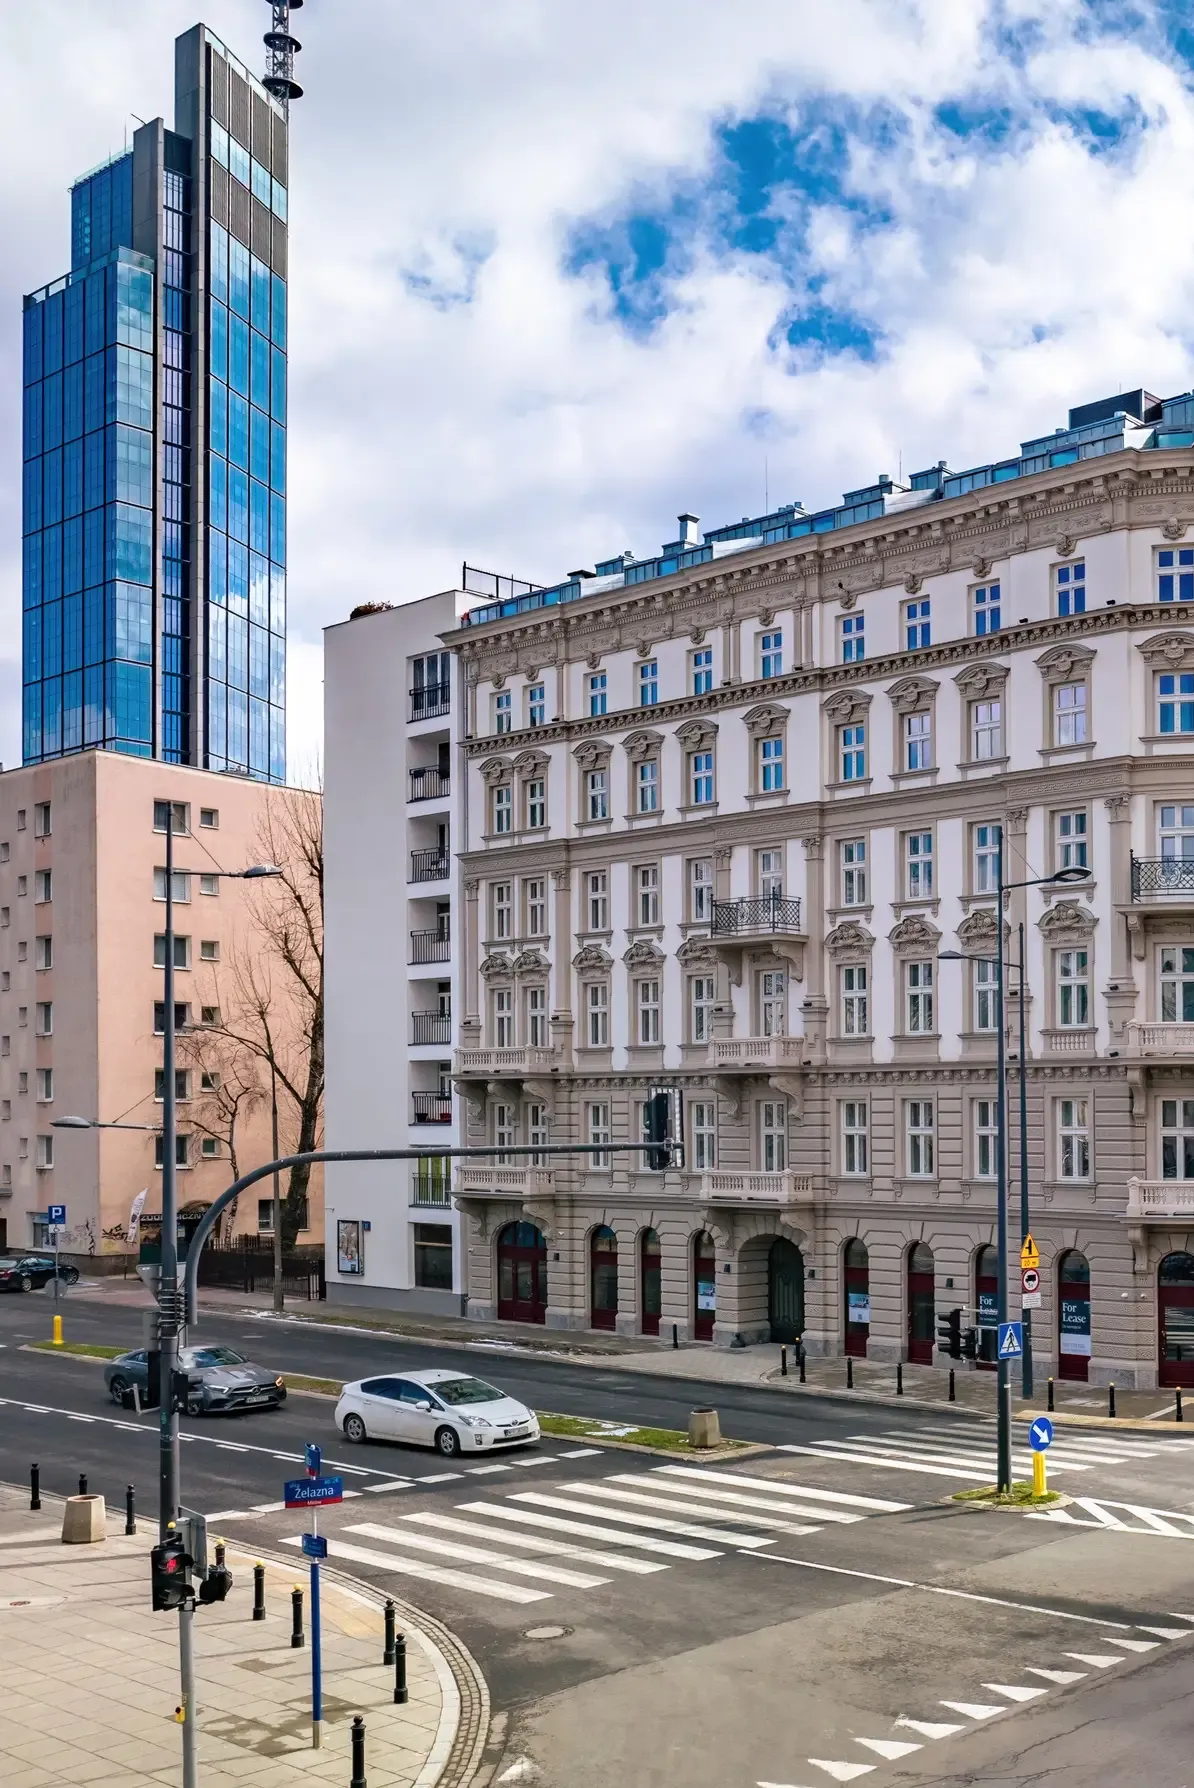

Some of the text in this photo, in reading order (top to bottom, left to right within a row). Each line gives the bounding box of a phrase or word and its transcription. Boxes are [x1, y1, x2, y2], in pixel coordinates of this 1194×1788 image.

[52, 1207, 62, 1219] P
[140, 1213, 206, 1221] ZOOICZN
[979, 1295, 993, 1306] For
[1062, 1302, 1077, 1312] For
[1062, 1312, 1087, 1323] Lease
[295, 1486, 334, 1499] Żelazna
